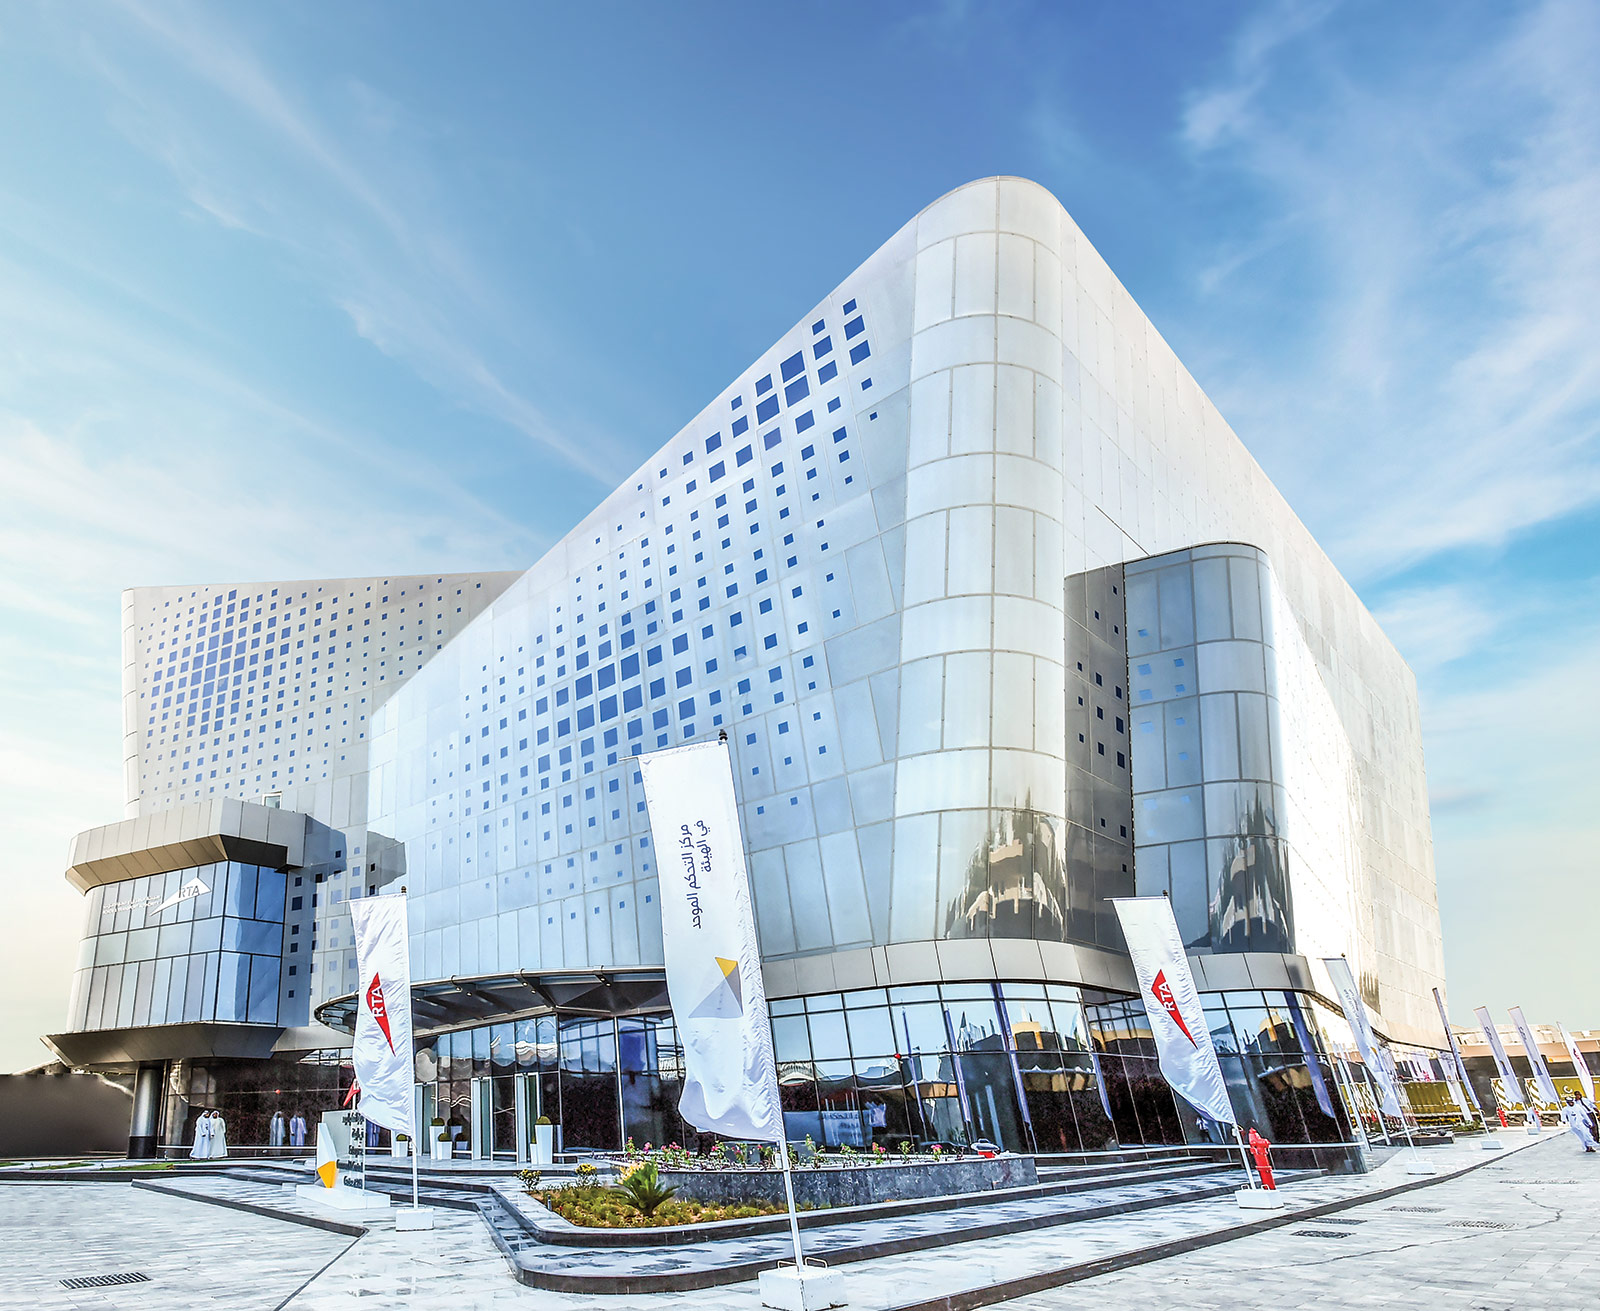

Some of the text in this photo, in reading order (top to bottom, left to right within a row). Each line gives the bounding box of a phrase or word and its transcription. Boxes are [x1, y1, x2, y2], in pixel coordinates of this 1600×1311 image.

[694, 820, 712, 872] في الهيئة
[178, 885, 201, 899] RTA
[679, 824, 703, 929] مركز التحكم الموحد
[371, 985, 384, 1018] RTA
[1158, 982, 1176, 1011] RTA
